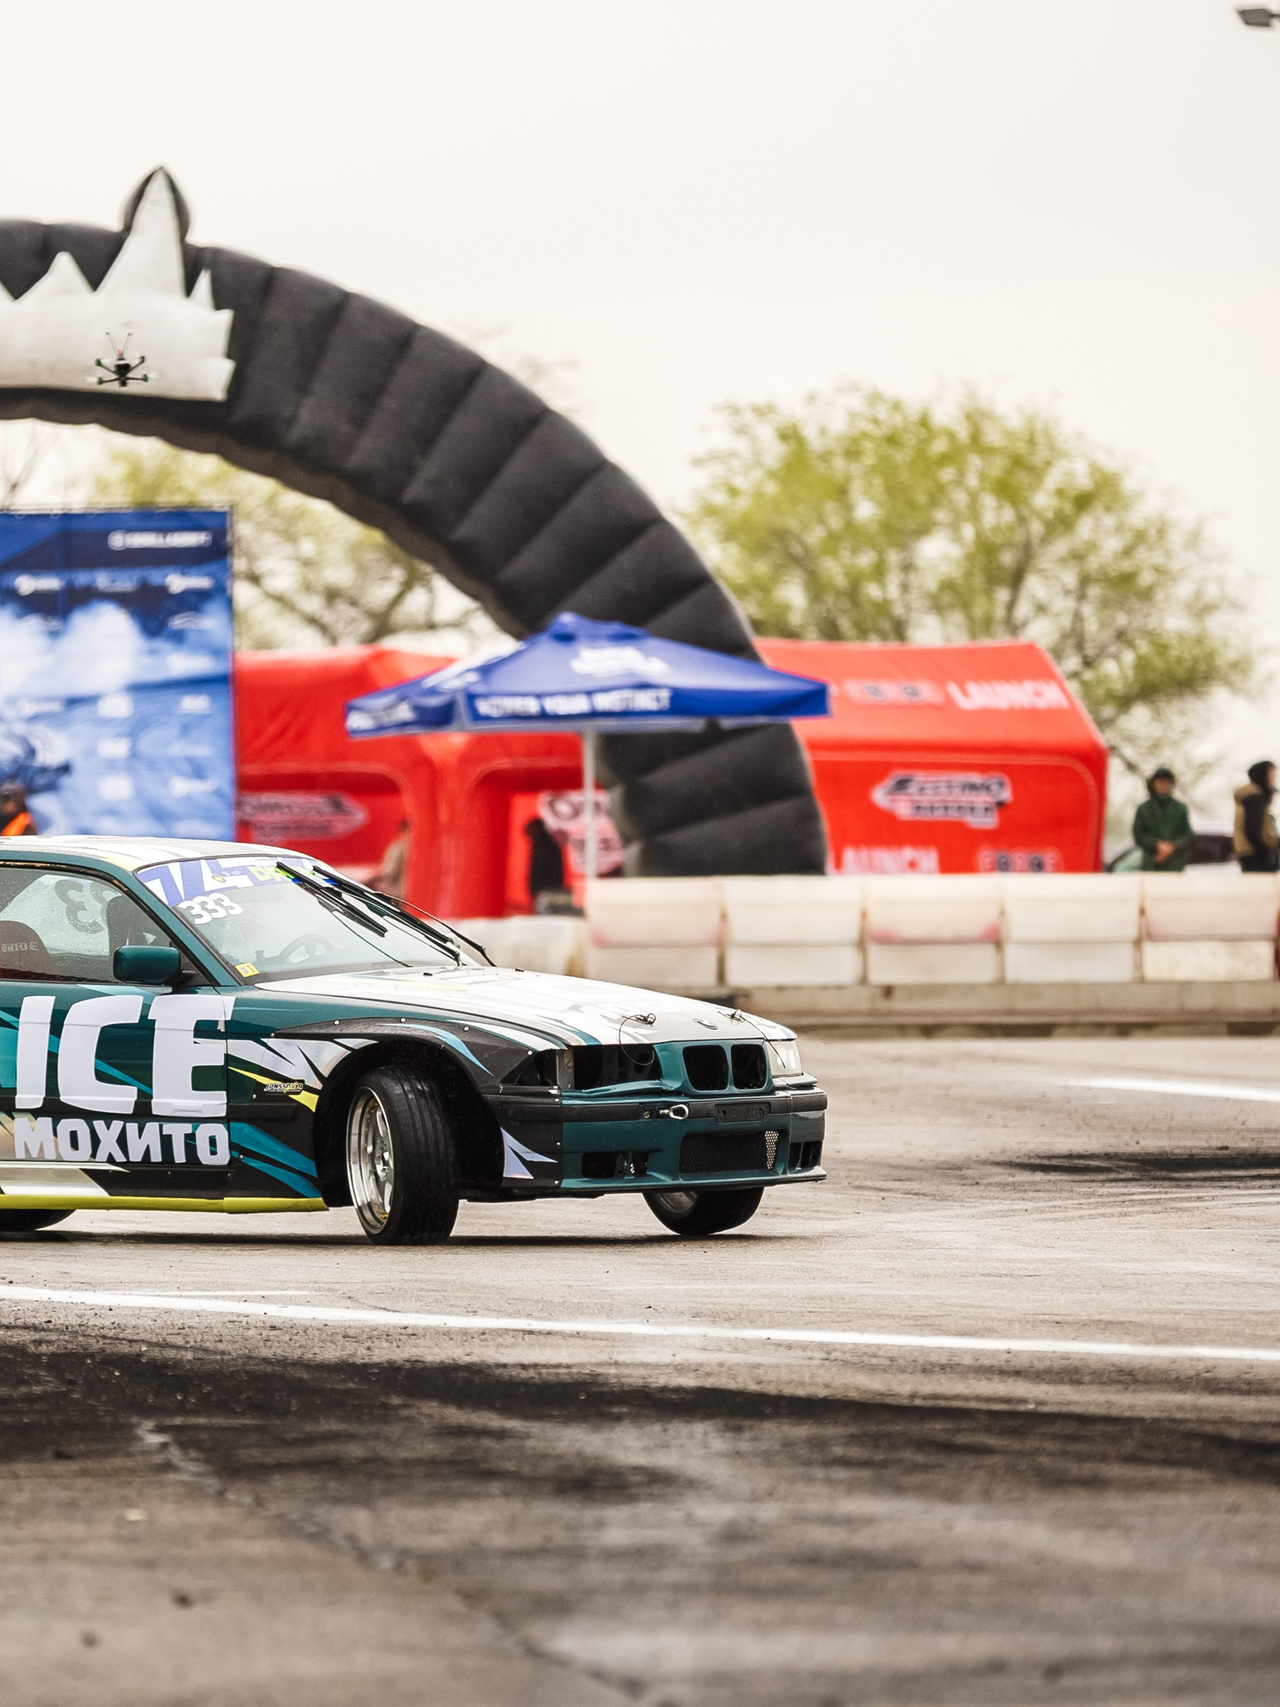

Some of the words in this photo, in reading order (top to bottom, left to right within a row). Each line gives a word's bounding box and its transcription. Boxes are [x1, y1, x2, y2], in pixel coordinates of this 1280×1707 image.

[946, 680, 1071, 711] LAUNCH
[178, 892, 244, 925] 333
[1, 941, 38, 953] BRIDE
[15, 994, 236, 1117] ICE
[13, 1117, 231, 1166] МОХИТО
